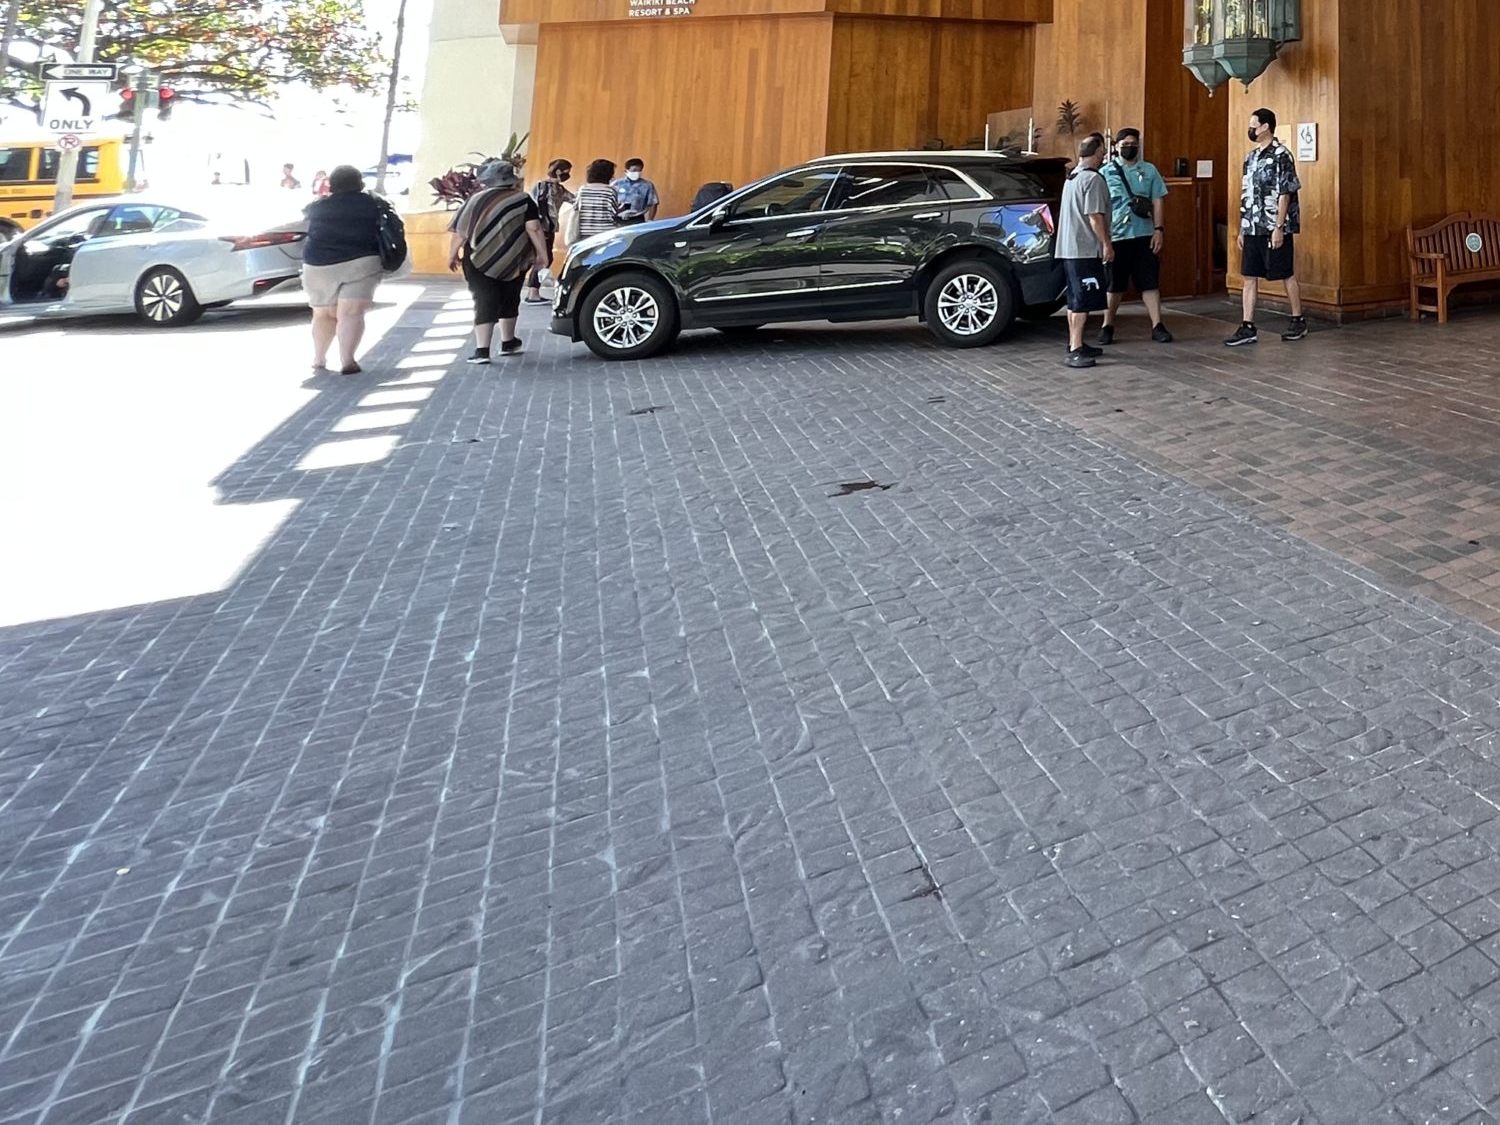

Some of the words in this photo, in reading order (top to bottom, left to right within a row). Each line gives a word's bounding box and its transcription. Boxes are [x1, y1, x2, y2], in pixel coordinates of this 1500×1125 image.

[628, 8, 663, 17] RESORT
[664, 7, 671, 16] &
[673, 7, 690, 15] SPA
[63, 68, 83, 76] ONE
[88, 68, 109, 76] WAY
[49, 119, 94, 130] ONLY
